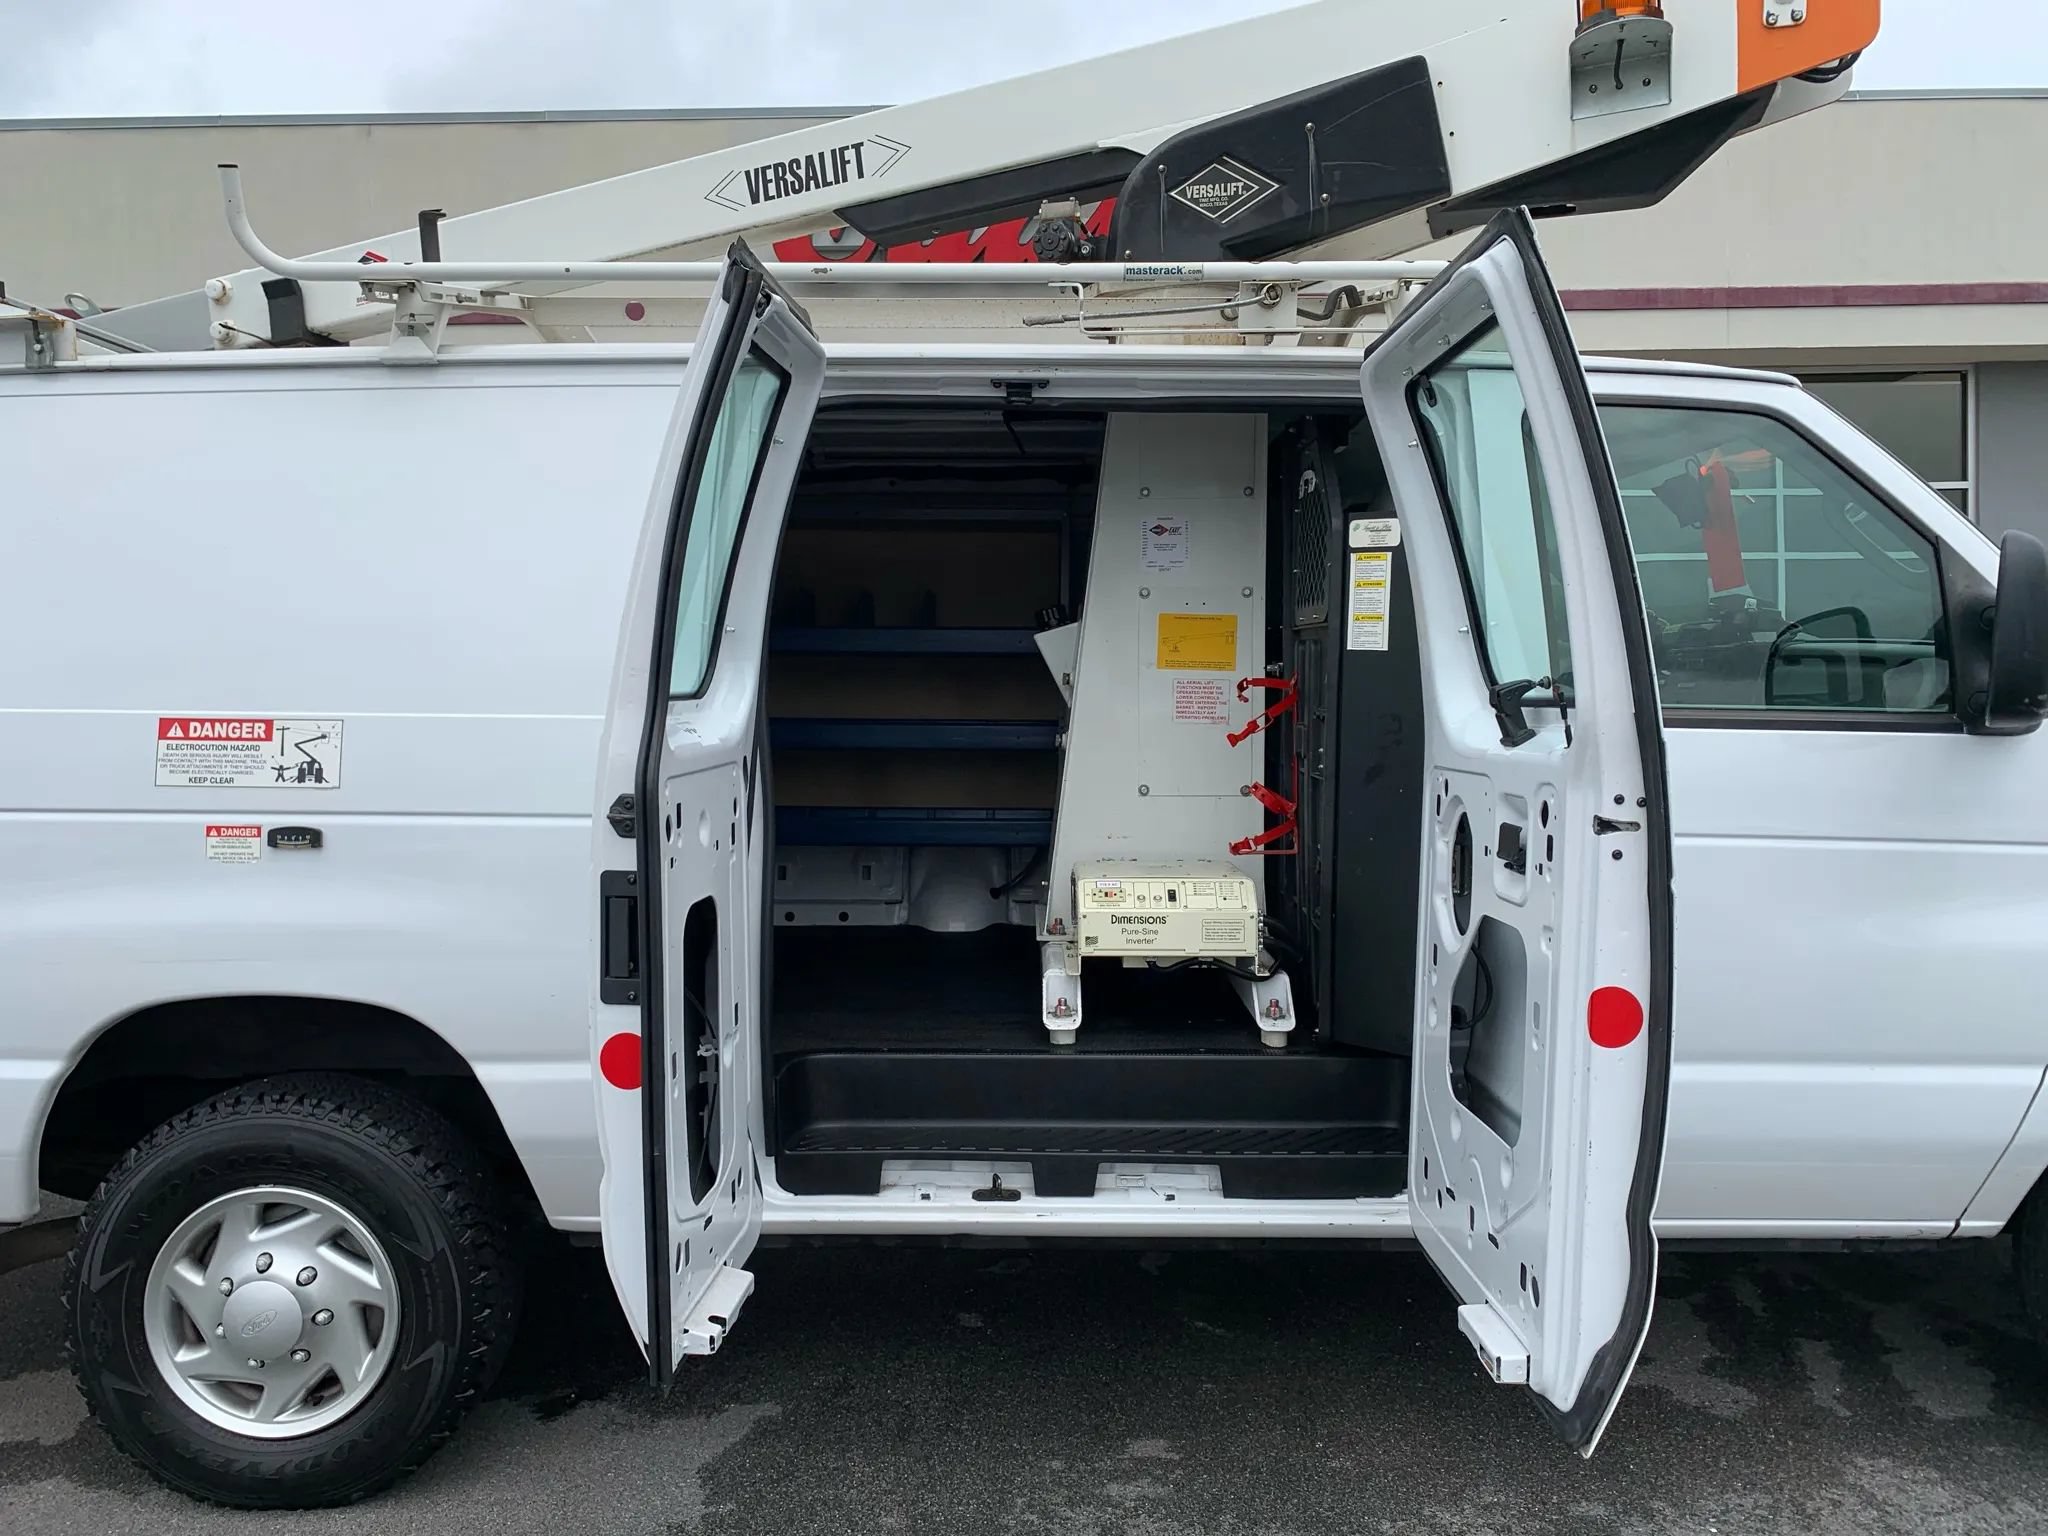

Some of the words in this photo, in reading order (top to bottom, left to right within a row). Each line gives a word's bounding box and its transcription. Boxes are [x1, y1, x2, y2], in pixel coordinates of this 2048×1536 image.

[744, 141, 865, 205] VERSALIFT
[1185, 182, 1244, 199] VERSALIFT
[188, 721, 267, 739] DANGER
[166, 743, 229, 752] ELECTROCUTION
[230, 744, 261, 752] HAZARD
[188, 776, 208, 784] KEEP
[209, 776, 234, 784] CLEAR
[220, 827, 258, 837] DANGER
[1121, 927, 1159, 935] Pure-Sine
